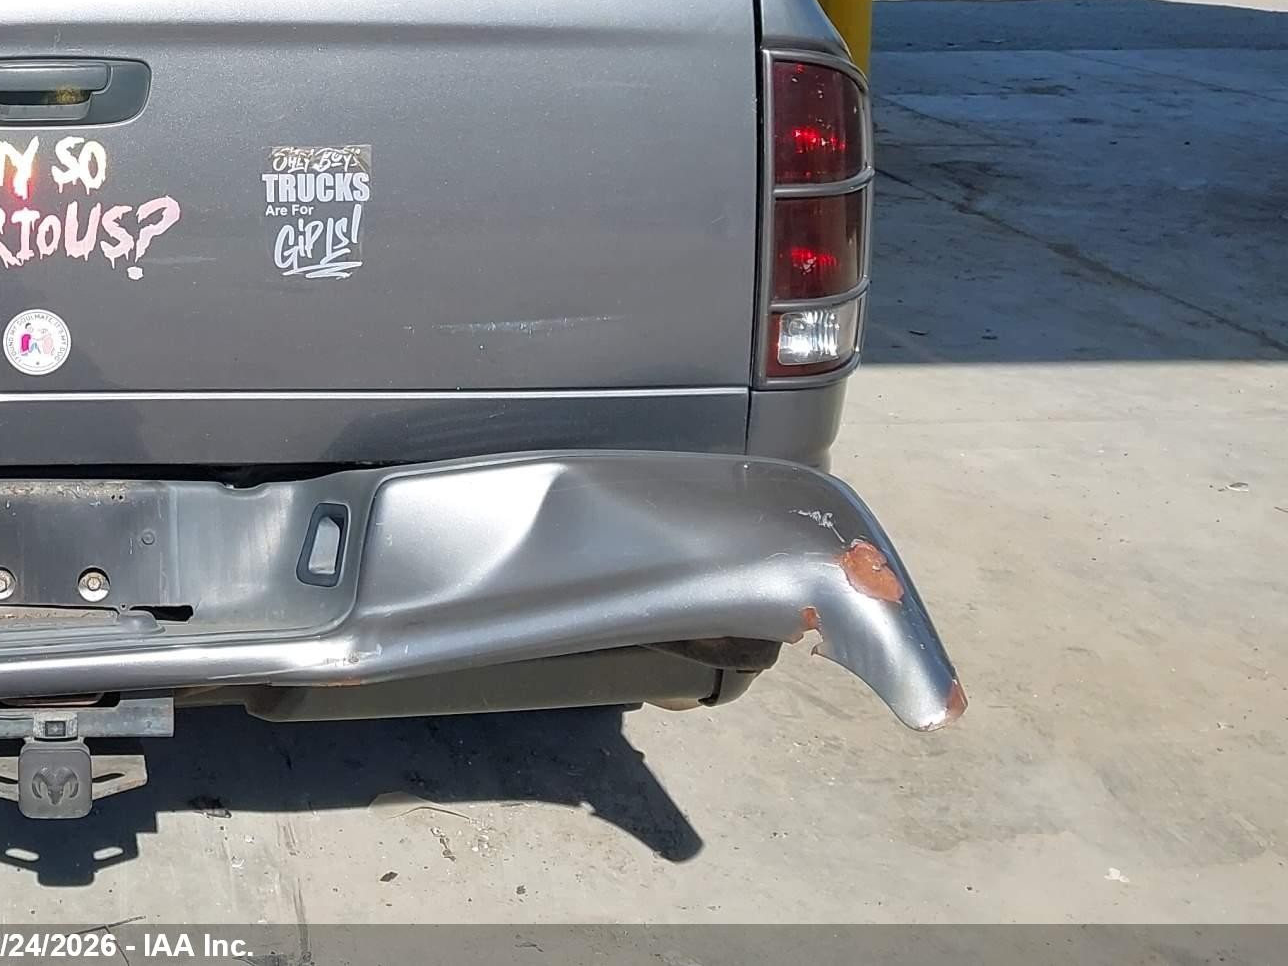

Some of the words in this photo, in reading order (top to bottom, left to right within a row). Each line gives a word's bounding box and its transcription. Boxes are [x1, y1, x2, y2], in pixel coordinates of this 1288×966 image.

[51, 136, 107, 194] SO
[262, 173, 370, 203] TRUCKS
[265, 205, 288, 216] Are
[292, 204, 314, 215] For
